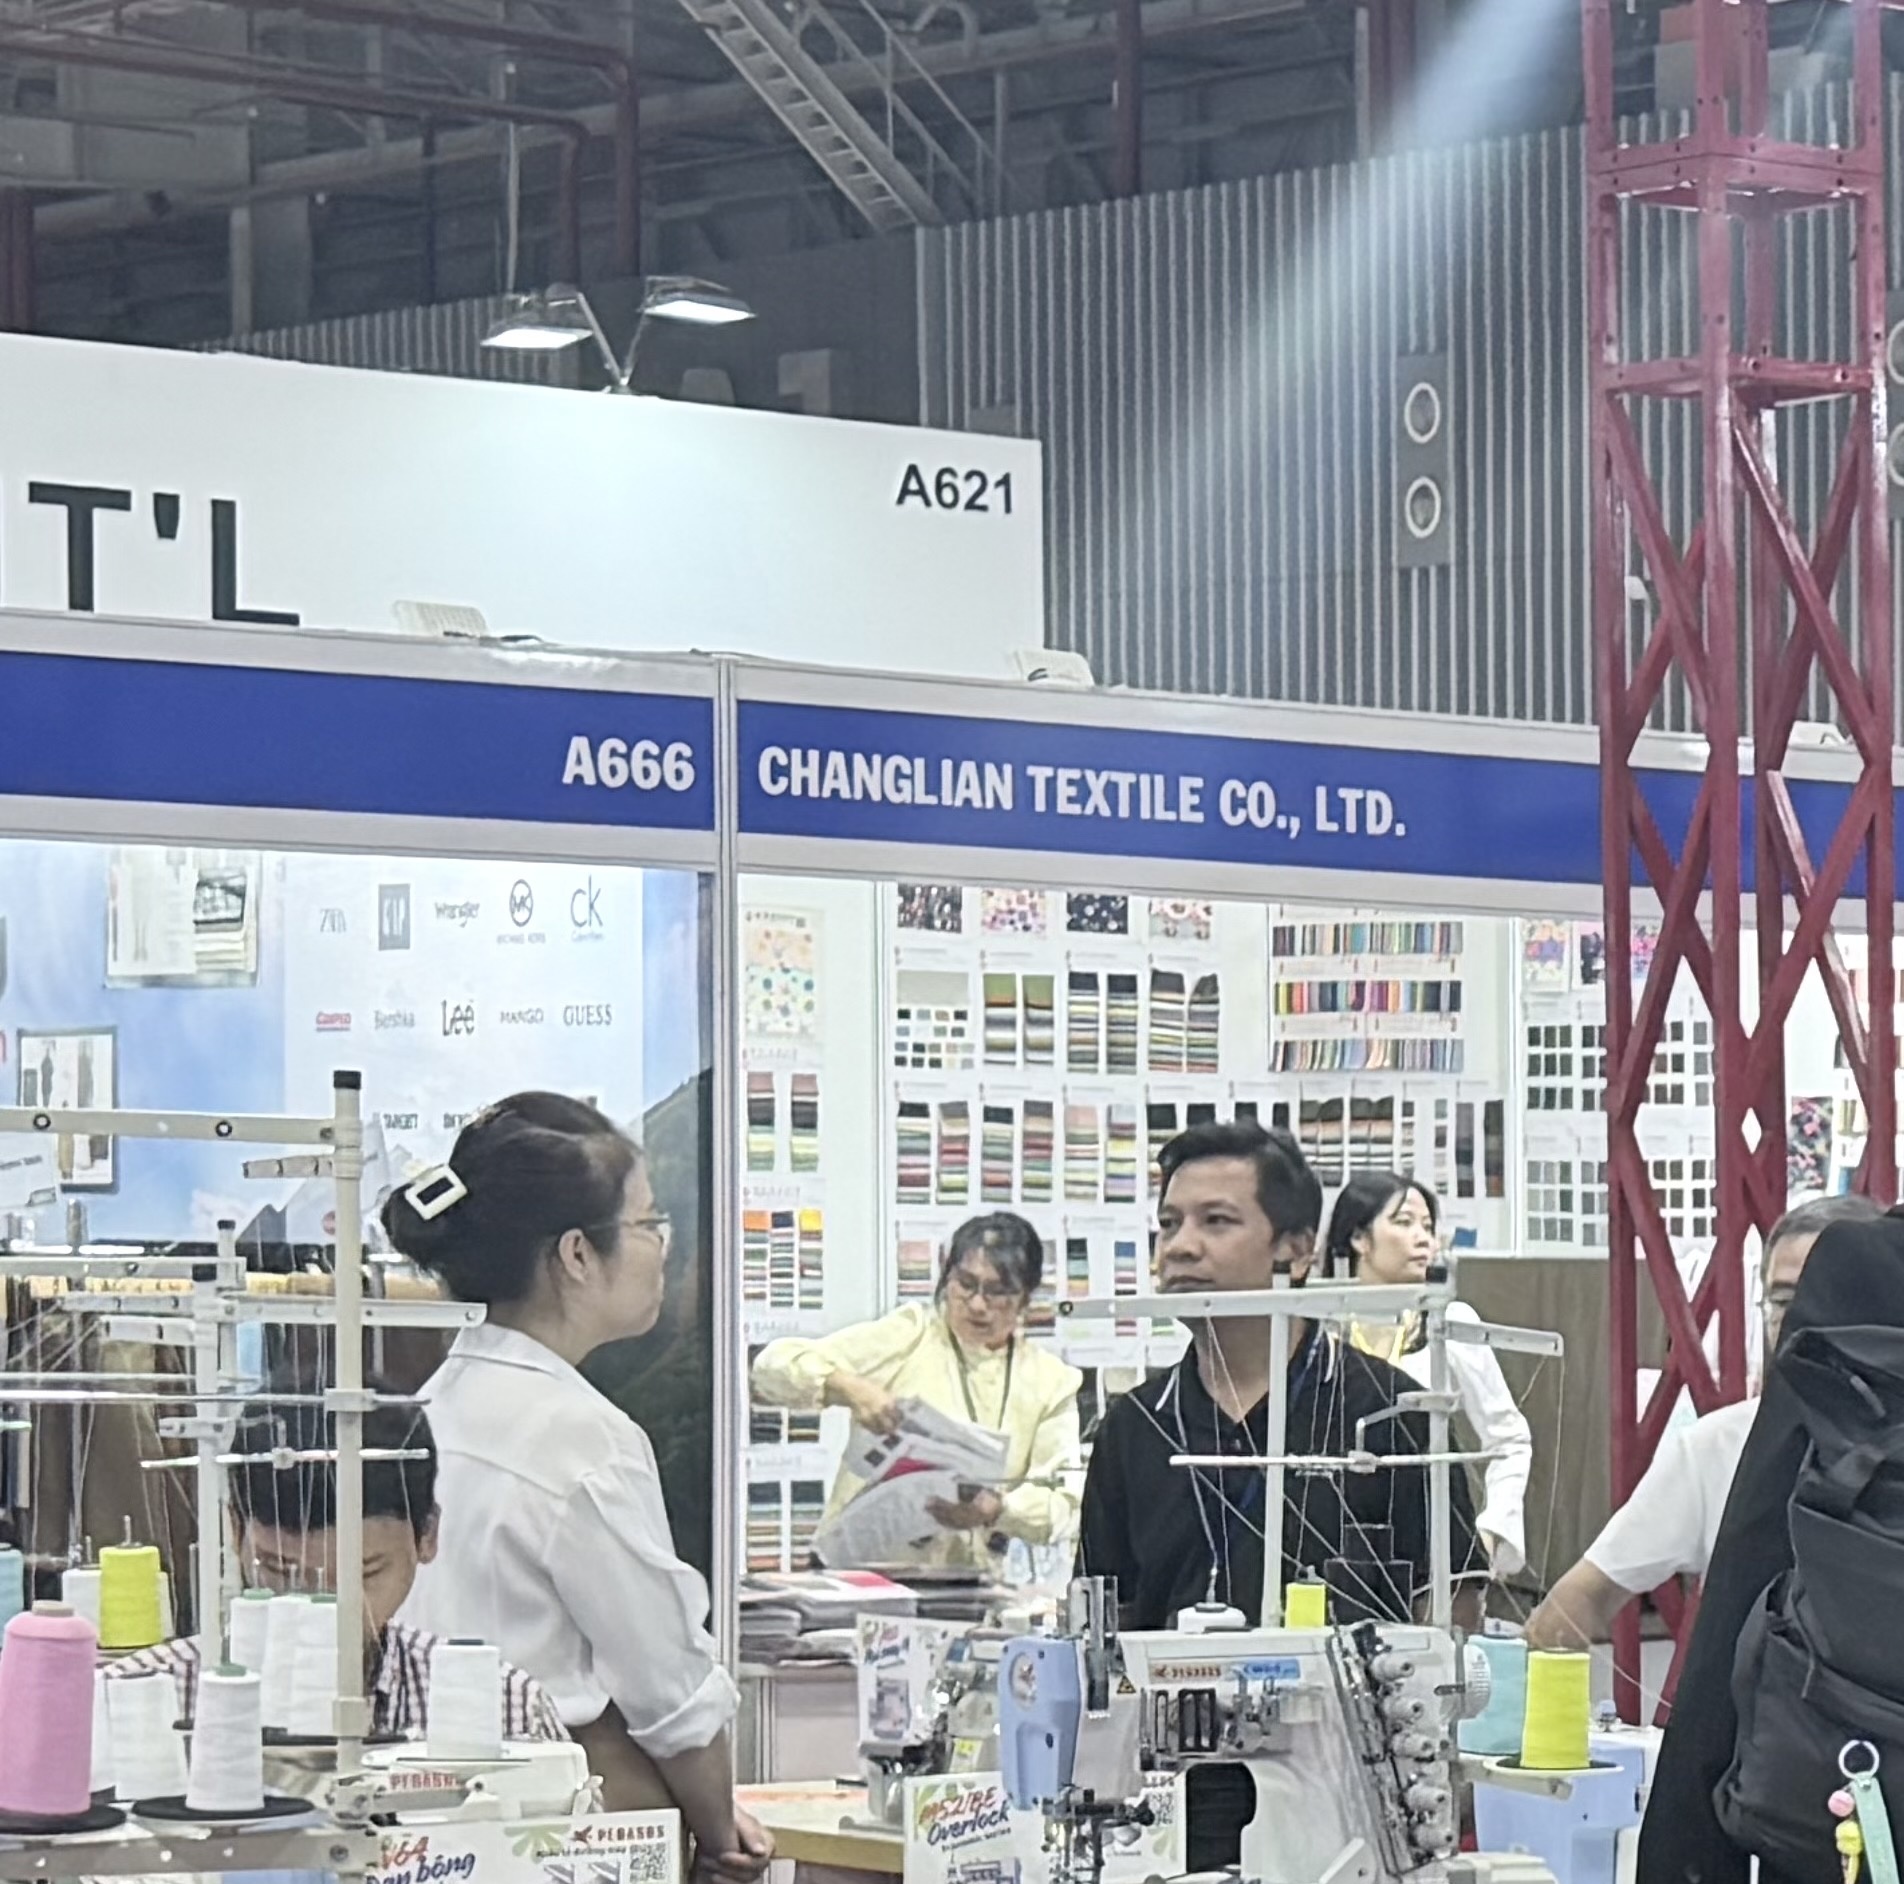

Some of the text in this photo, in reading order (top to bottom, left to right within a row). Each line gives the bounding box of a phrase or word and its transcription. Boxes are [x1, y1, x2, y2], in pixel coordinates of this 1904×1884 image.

[896, 464, 1014, 515] A621
[562, 736, 695, 791] A666
[757, 745, 1407, 839] CHANGLIAN TEXTILE CO., LTD.
[563, 1004, 613, 1027] GUESS
